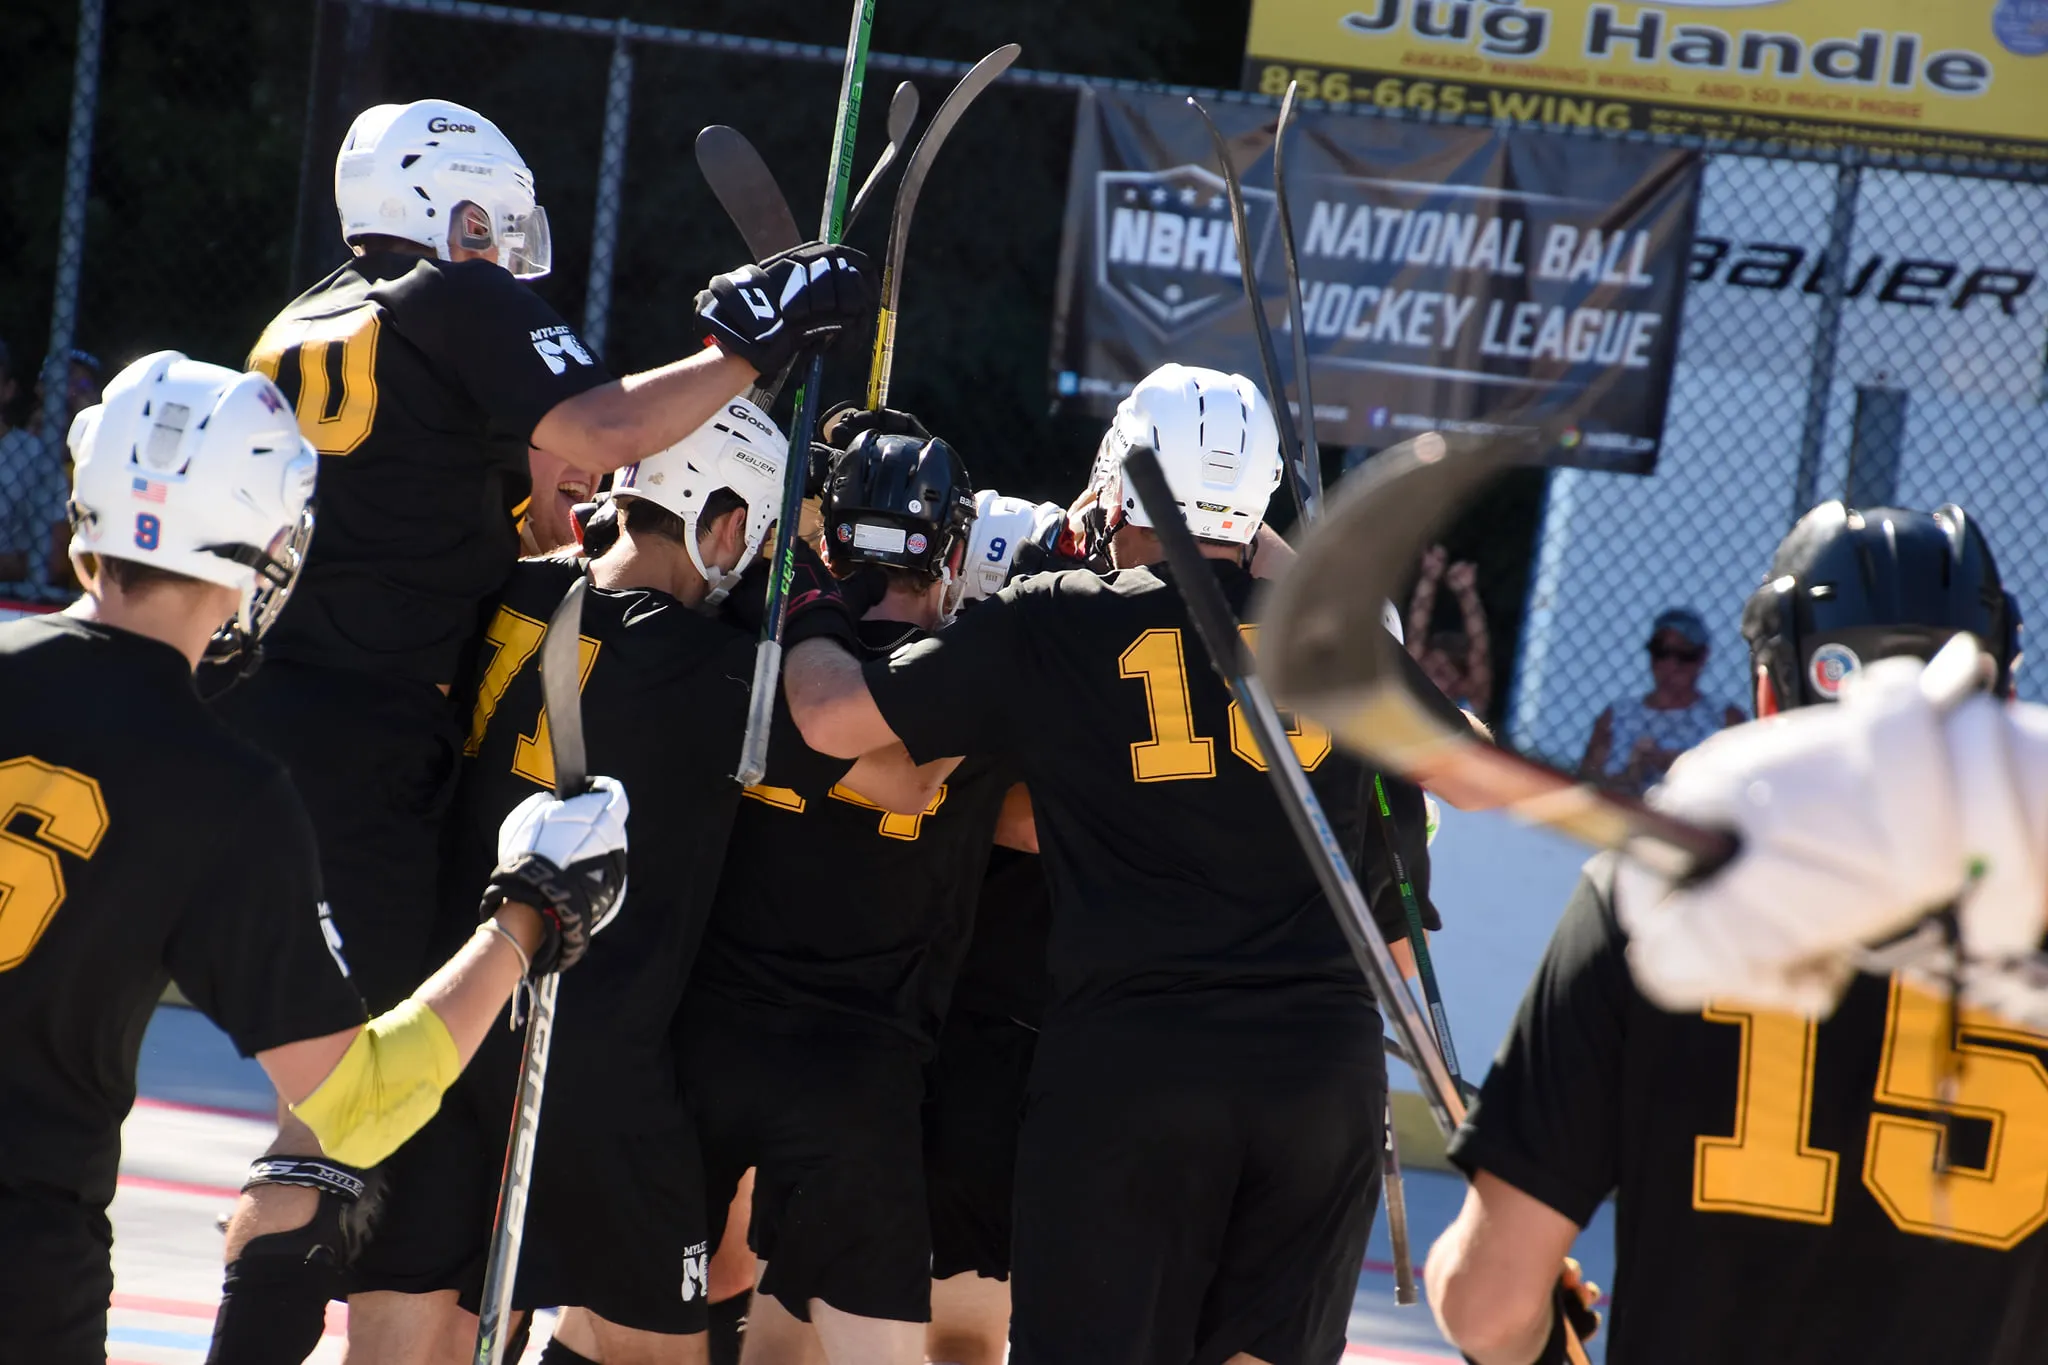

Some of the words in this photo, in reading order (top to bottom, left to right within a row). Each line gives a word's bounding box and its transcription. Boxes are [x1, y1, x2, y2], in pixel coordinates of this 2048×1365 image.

[1343, 0, 1549, 57] Jug
[1587, 6, 1990, 93] Handle
[1260, 66, 1631, 130] 856-665-WING
[1109, 207, 1244, 276] NBHL
[1305, 201, 1525, 274] NATIONAL
[1536, 223, 1654, 288] BALL
[529, 325, 570, 341] MYLEC
[1281, 280, 1476, 349] HOCKEY
[1480, 300, 1662, 367] LEAGUE
[1117, 429, 1129, 449] CCM
[134, 512, 161, 552] 9
[986, 537, 1007, 562] 9
[781, 548, 794, 595] CCM
[1693, 966, 2048, 1251] 15
